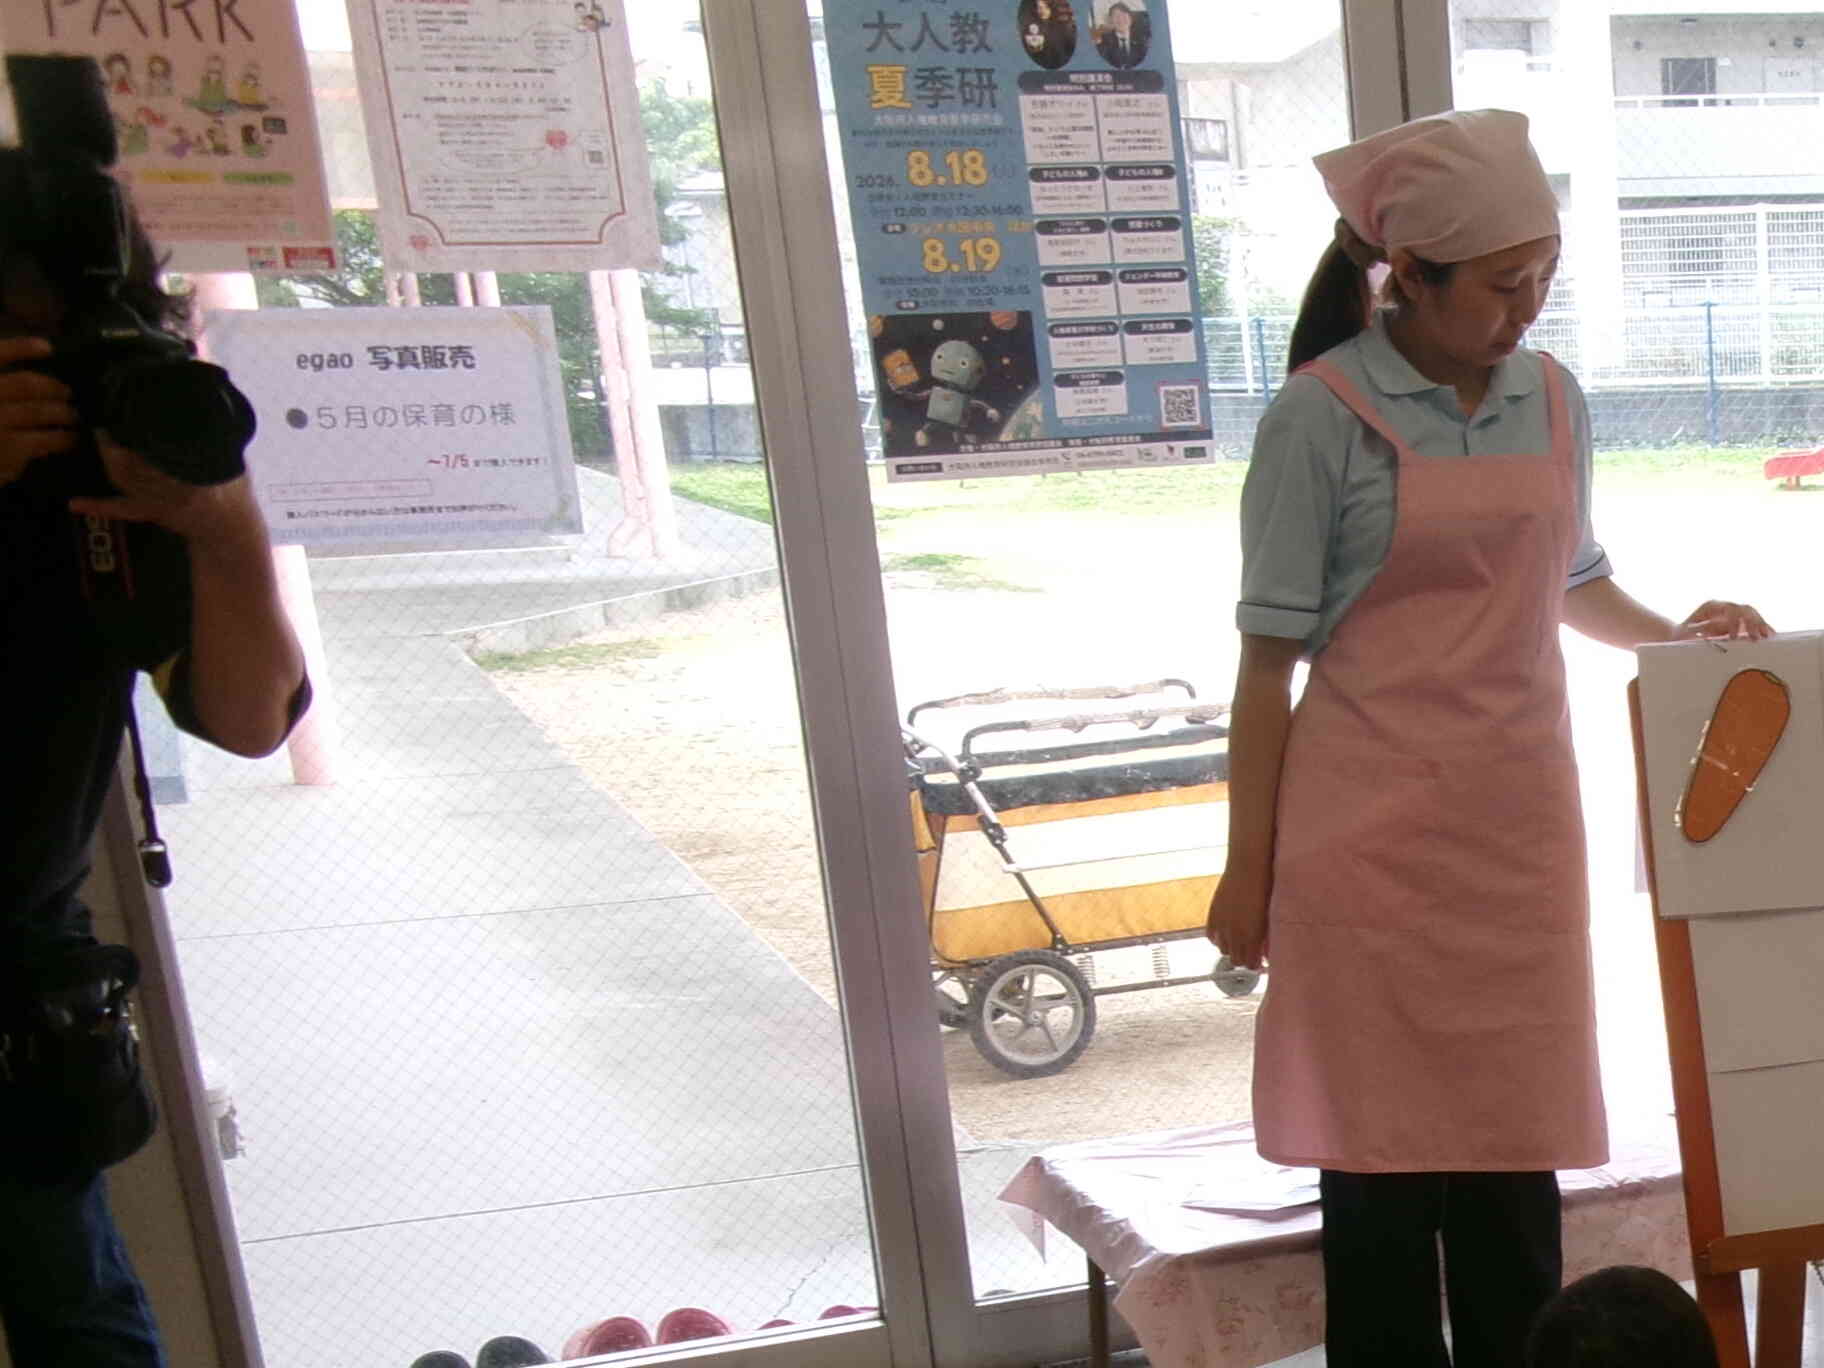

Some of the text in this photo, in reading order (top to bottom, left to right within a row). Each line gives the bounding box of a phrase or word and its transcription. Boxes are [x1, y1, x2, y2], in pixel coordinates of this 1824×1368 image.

[862, 10, 993, 53] 大人教
[866, 64, 999, 109] 夏季研
[906, 148, 989, 187] 8.18
[922, 237, 1003, 273] 8.19
[296, 346, 476, 372] egao 写真販売
